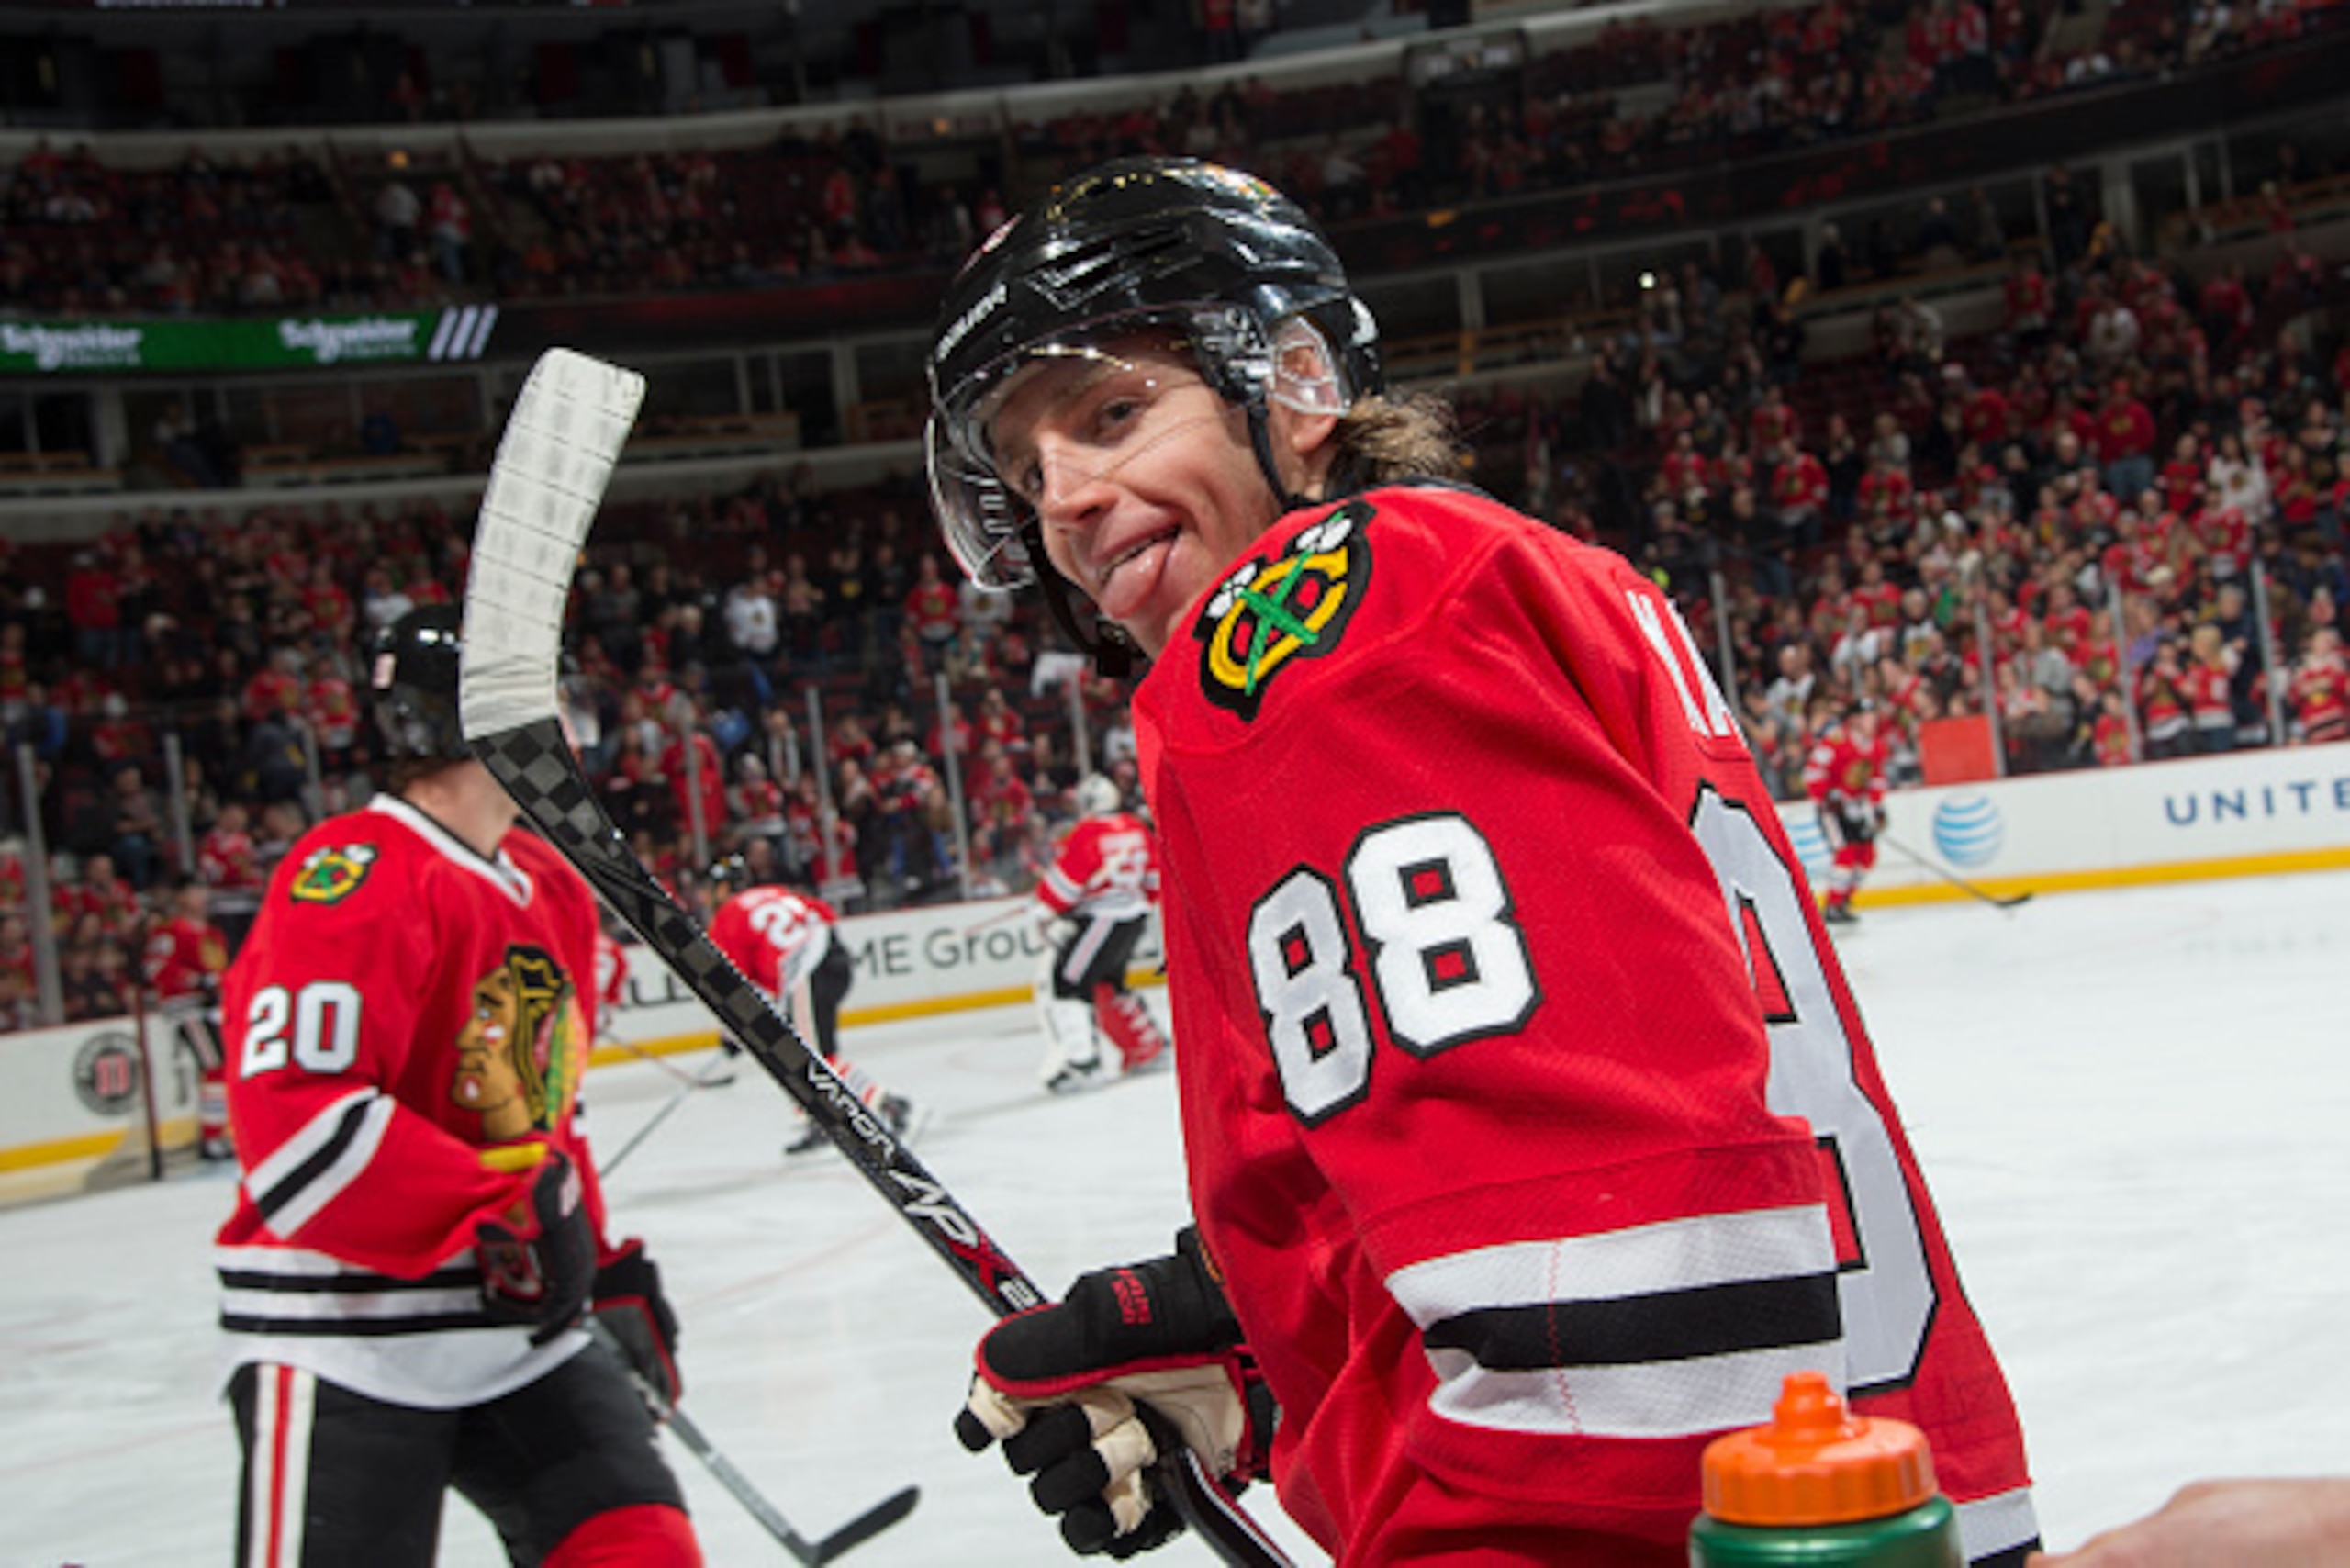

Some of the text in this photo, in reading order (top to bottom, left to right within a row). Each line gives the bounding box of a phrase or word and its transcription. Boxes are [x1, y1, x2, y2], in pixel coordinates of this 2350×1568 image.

[2164, 777, 2350, 827] UNITE
[852, 925, 1046, 980] ME Grou
[1246, 809, 1545, 1130] 88
[240, 980, 362, 1081] 20
[806, 1059, 896, 1162] VAPOR
